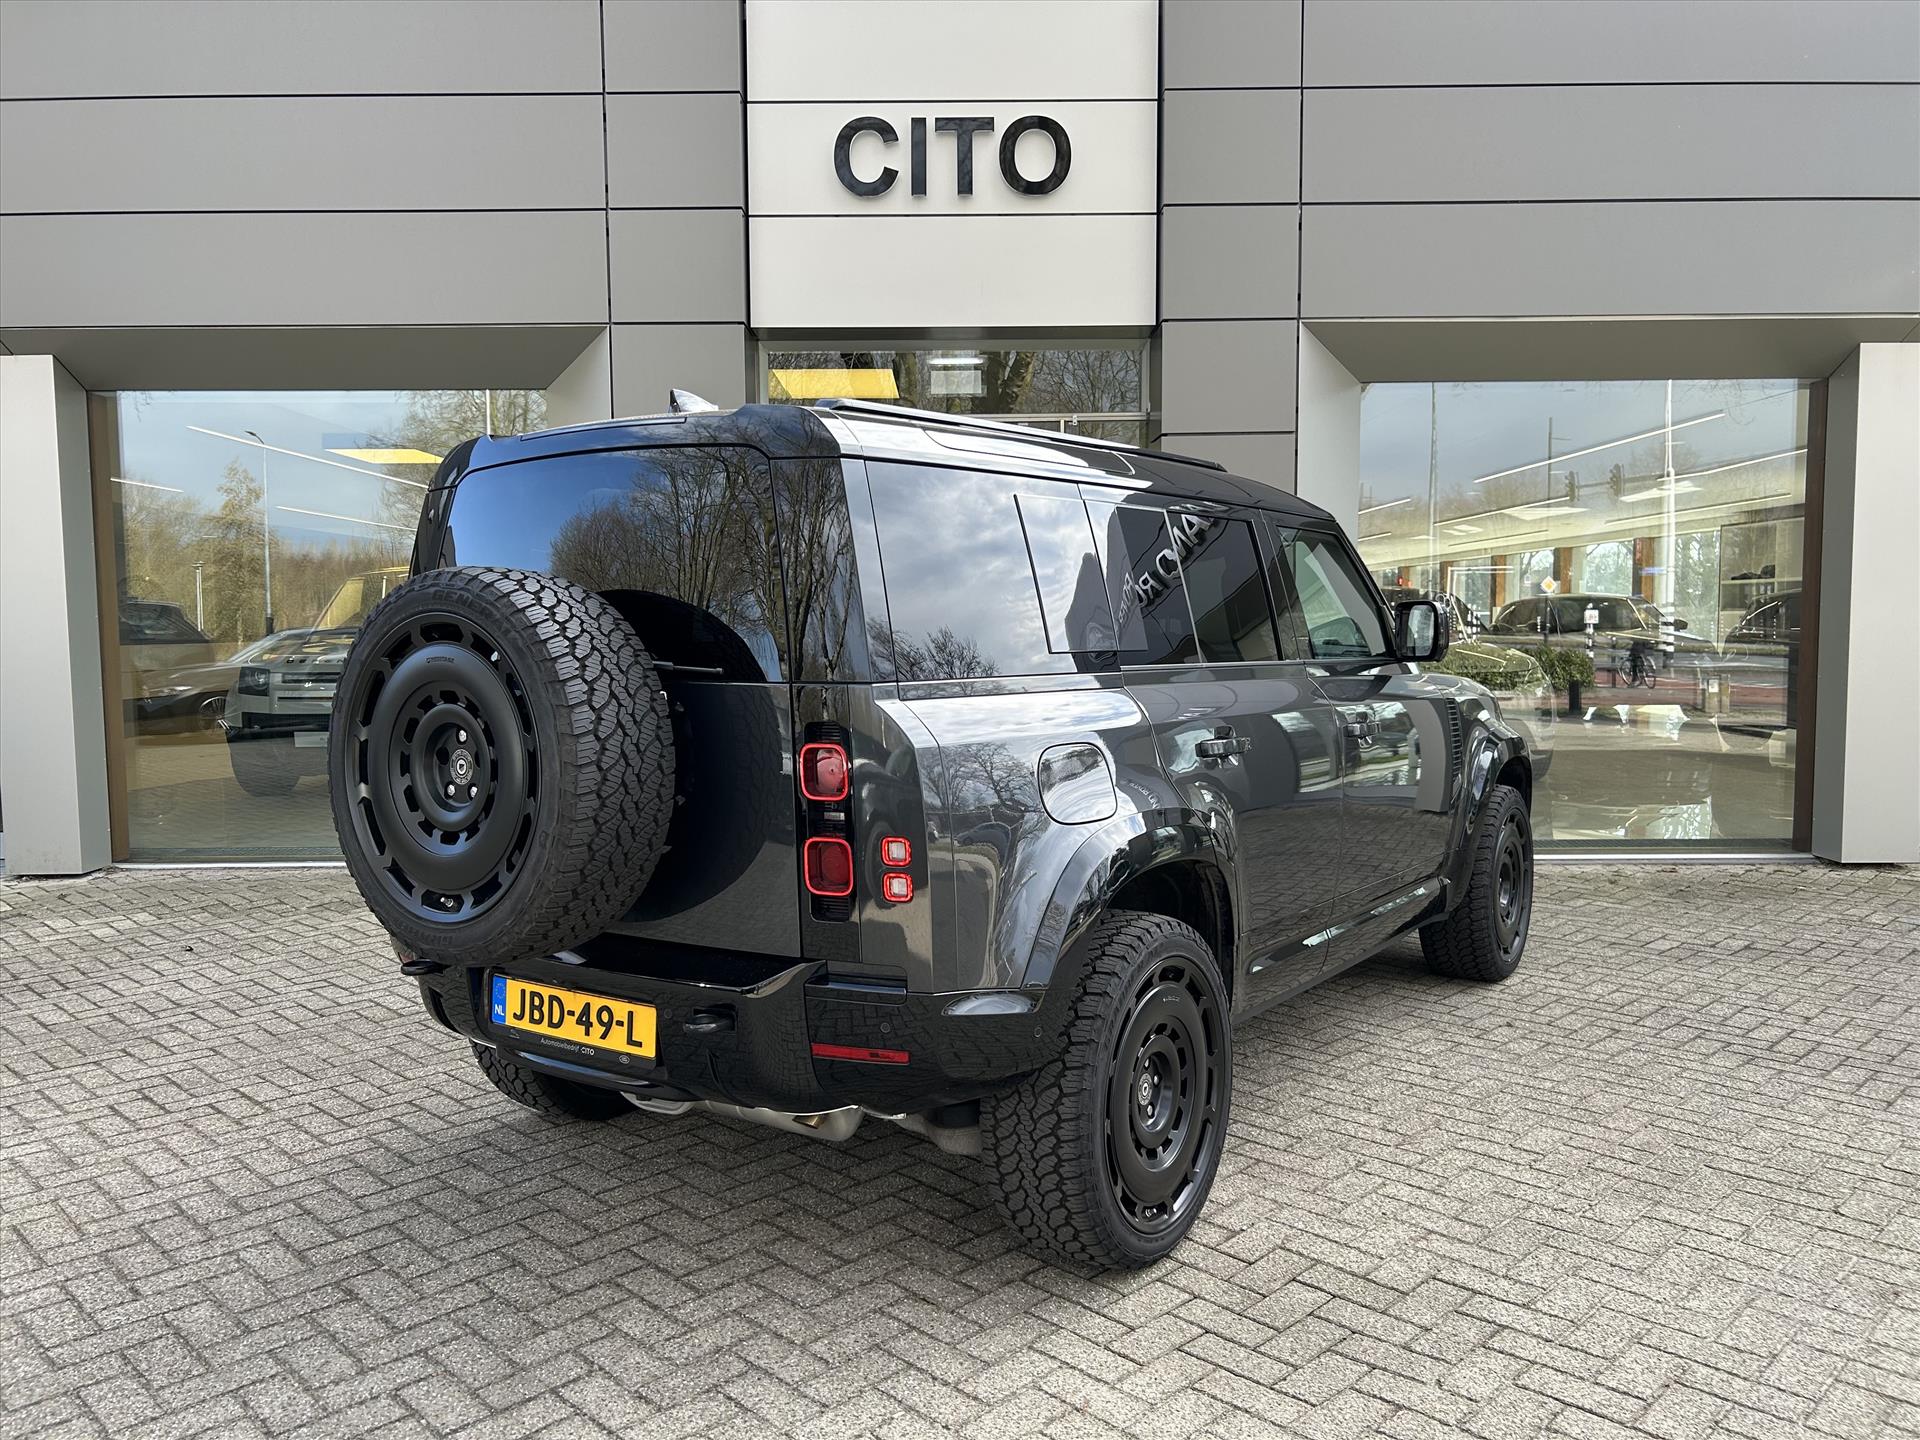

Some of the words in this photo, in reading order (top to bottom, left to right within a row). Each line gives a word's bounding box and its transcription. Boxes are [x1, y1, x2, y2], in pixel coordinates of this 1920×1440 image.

[834, 115, 1072, 197] CITO
[494, 1003, 505, 1016] NL
[513, 988, 643, 1048] JBD-49-L
[580, 1046, 595, 1056] CITO
